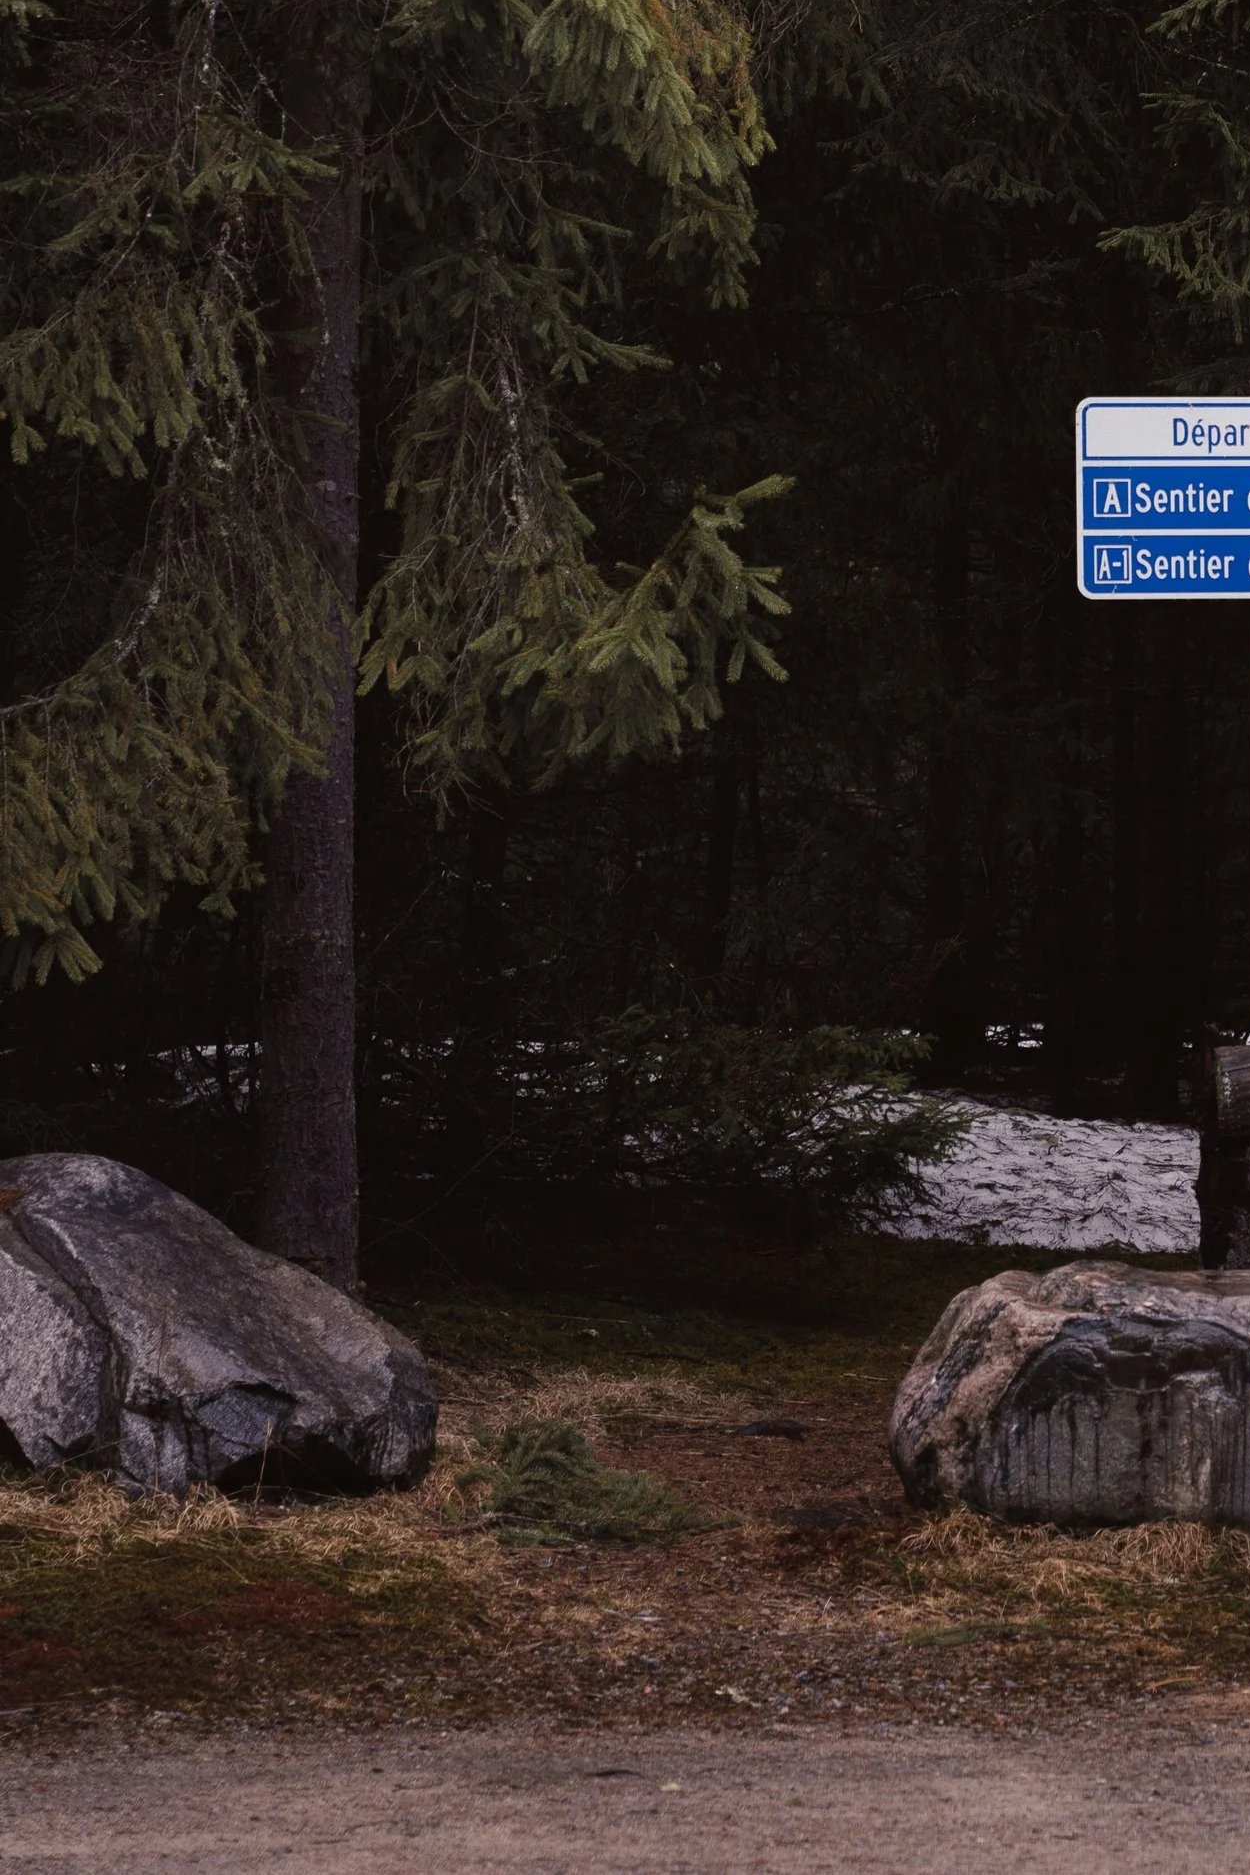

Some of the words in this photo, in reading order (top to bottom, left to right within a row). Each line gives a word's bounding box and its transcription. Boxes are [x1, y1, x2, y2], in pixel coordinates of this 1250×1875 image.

[1103, 482, 1122, 514] A
[1135, 482, 1234, 513] Sentier
[1098, 549, 1128, 580] A-1
[1136, 548, 1235, 579] Sentier
